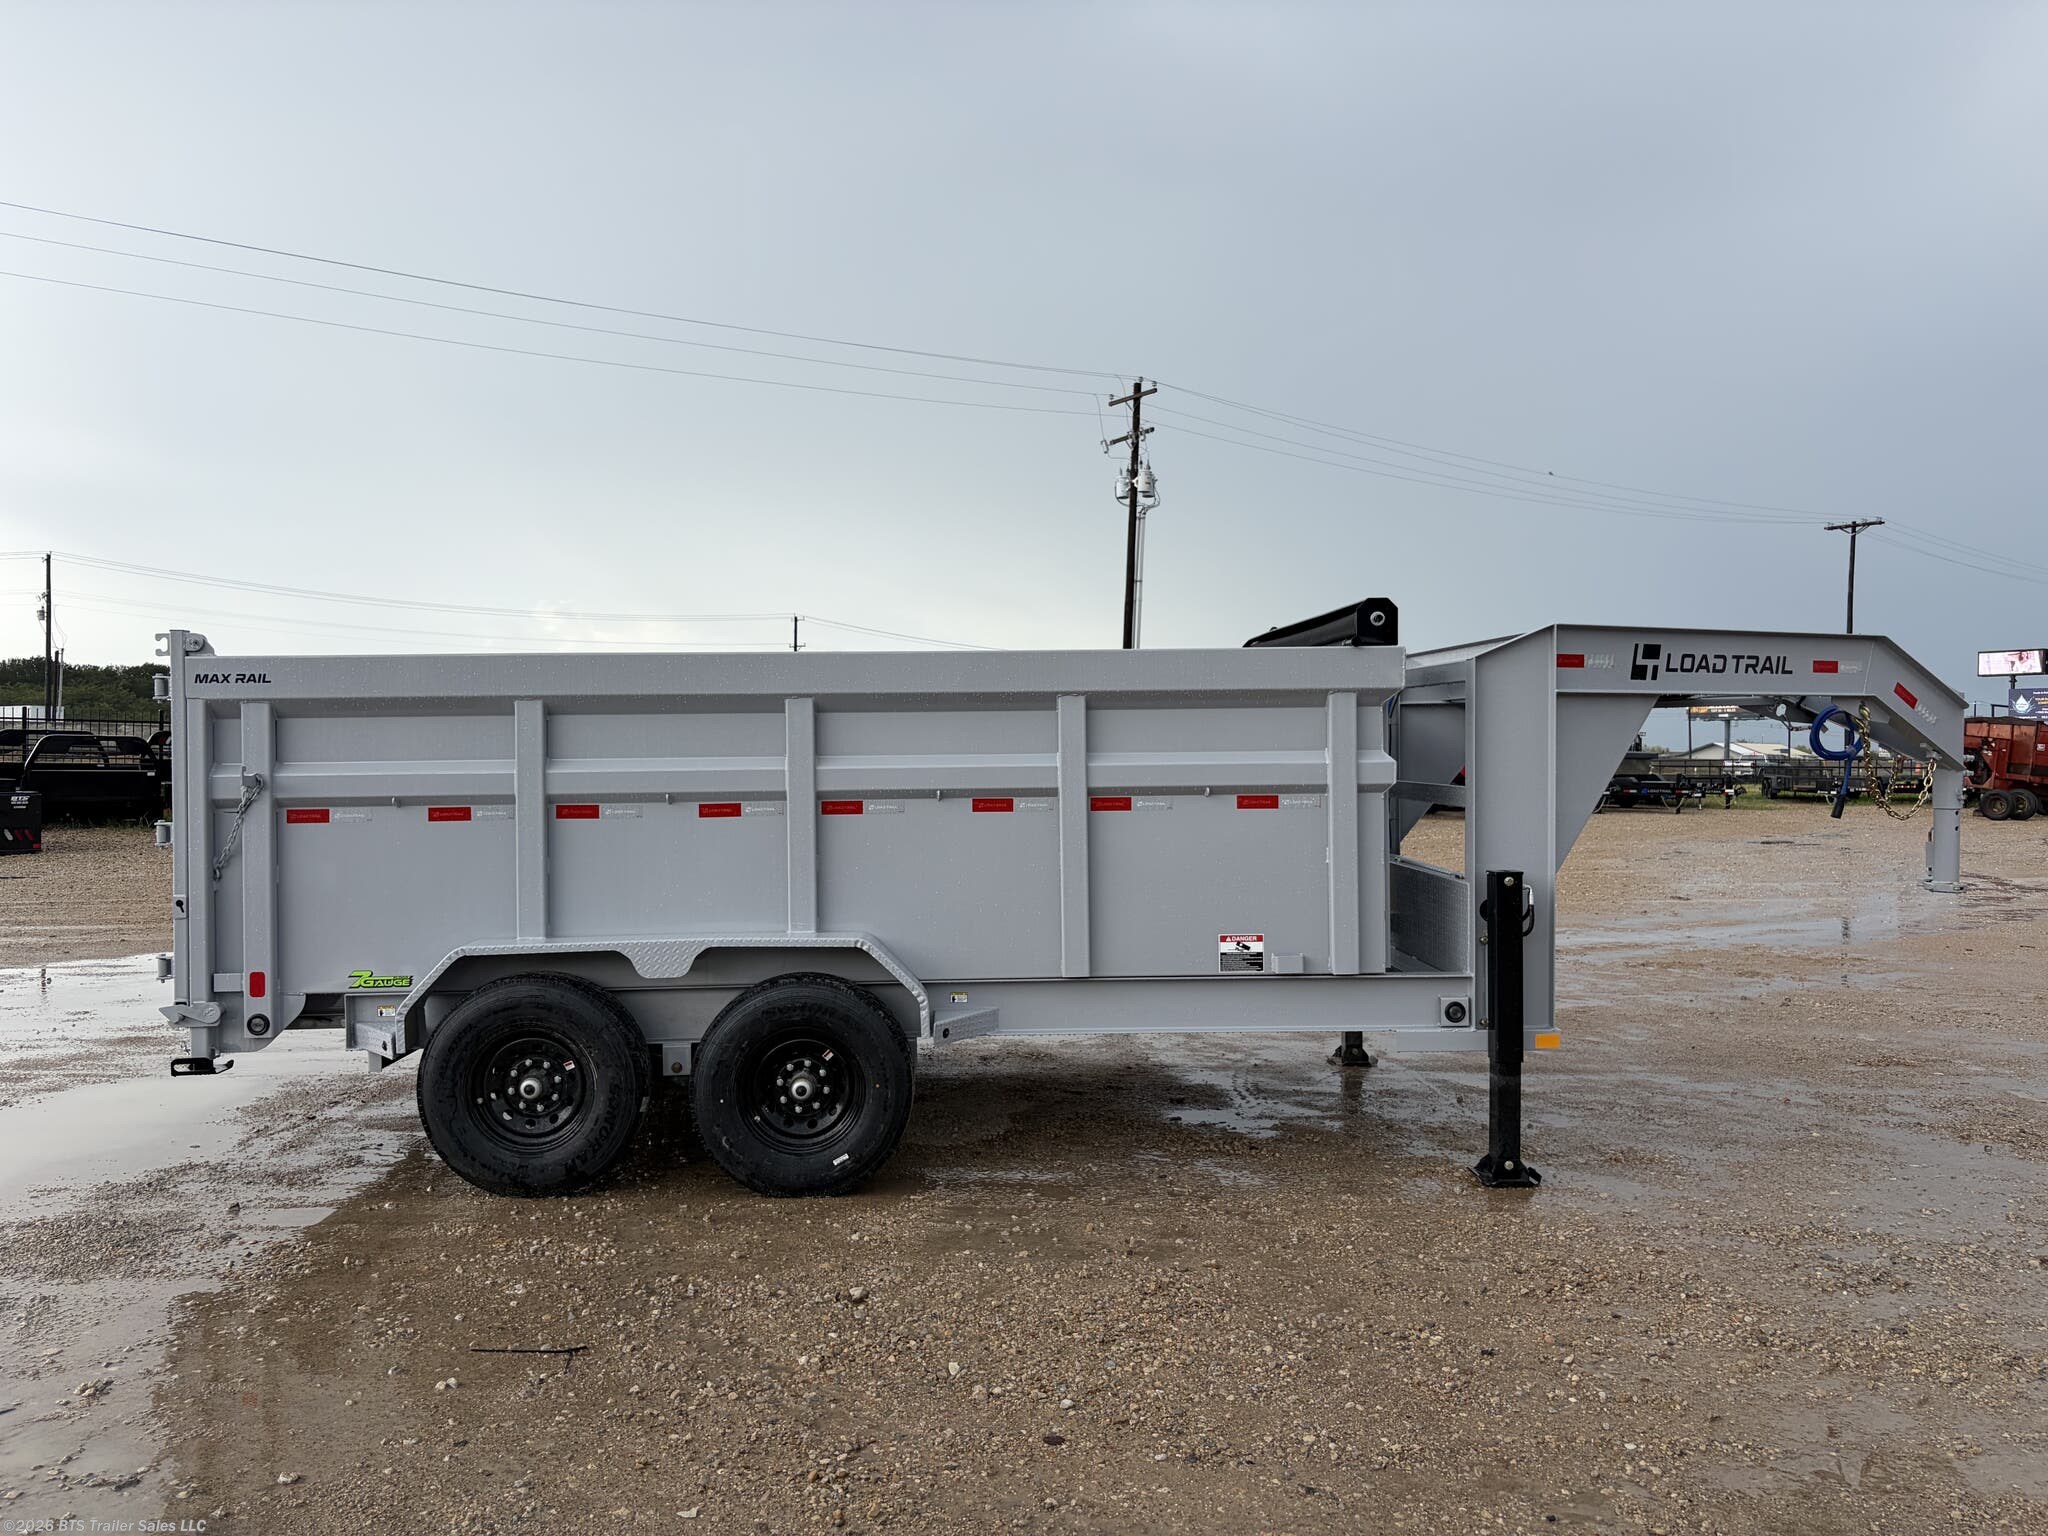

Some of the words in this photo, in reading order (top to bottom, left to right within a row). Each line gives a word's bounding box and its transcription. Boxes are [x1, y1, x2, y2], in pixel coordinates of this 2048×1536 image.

[1665, 653, 1727, 674] LOAD
[1731, 655, 1793, 675] TRAIL
[195, 673, 231, 684] MAX
[235, 673, 271, 684] RAIL
